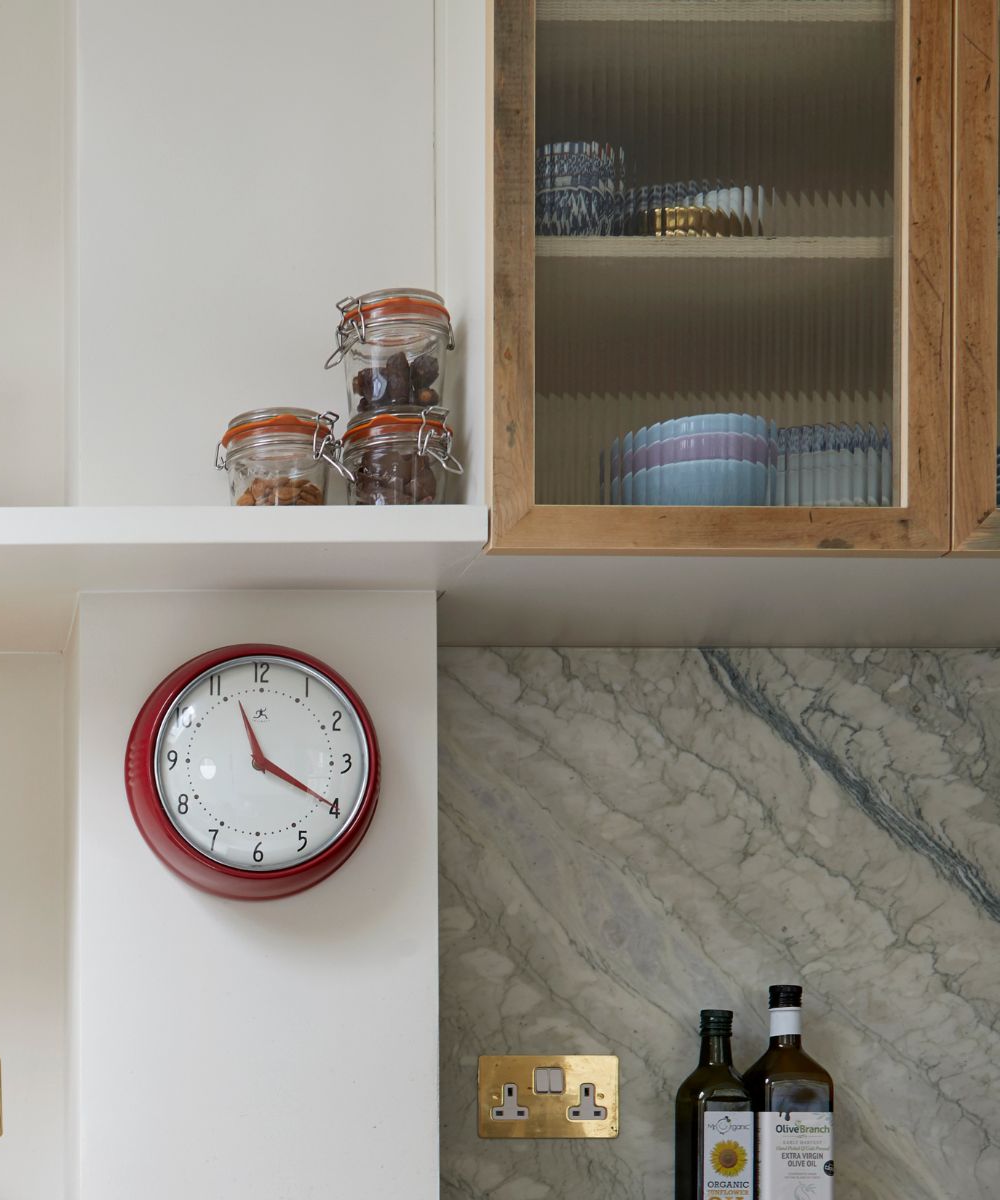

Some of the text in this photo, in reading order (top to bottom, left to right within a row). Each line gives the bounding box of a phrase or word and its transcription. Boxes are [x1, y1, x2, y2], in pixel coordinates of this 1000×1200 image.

[253, 662, 270, 683] 12
[209, 675, 221, 696] 11
[175, 706, 192, 728] 10
[332, 711, 342, 731] 2
[167, 750, 178, 770] 9
[340, 753, 352, 774] 3
[178, 794, 188, 814] 8
[329, 798, 340, 819] 4
[208, 829, 219, 851] 7
[297, 831, 308, 852] 5
[253, 841, 263, 862] 6
[775, 1124, 830, 1133] OliveBranch
[707, 1181, 750, 1189] ORGANIC
